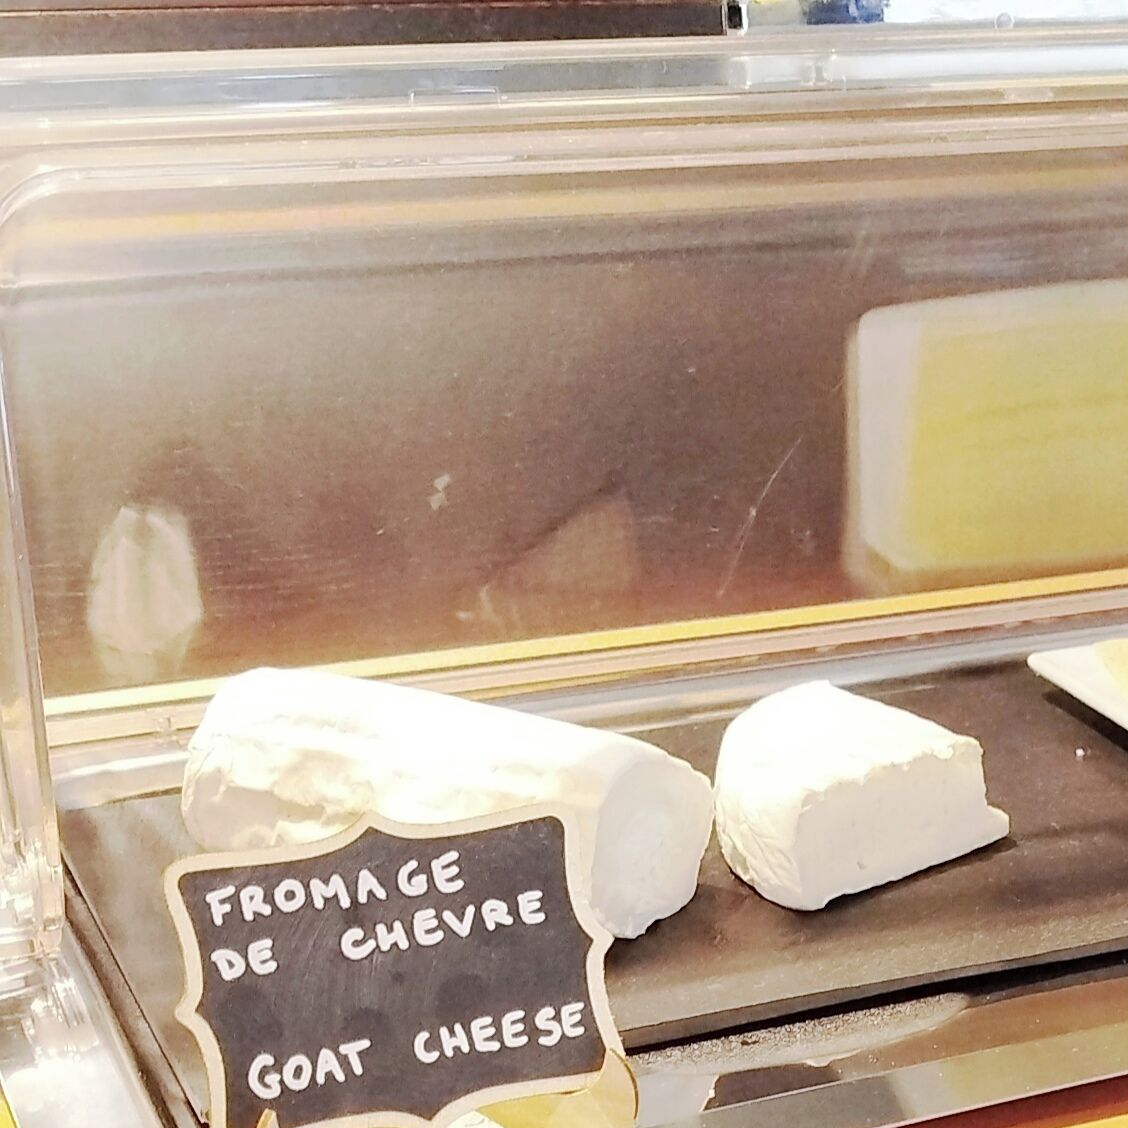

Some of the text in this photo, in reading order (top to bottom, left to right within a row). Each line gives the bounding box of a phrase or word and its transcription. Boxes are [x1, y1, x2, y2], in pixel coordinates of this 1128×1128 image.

[204, 850, 465, 926] FROMAGE
[210, 890, 547, 981] DE CHEVRE
[248, 1001, 586, 1101] GOAT CHEESE
